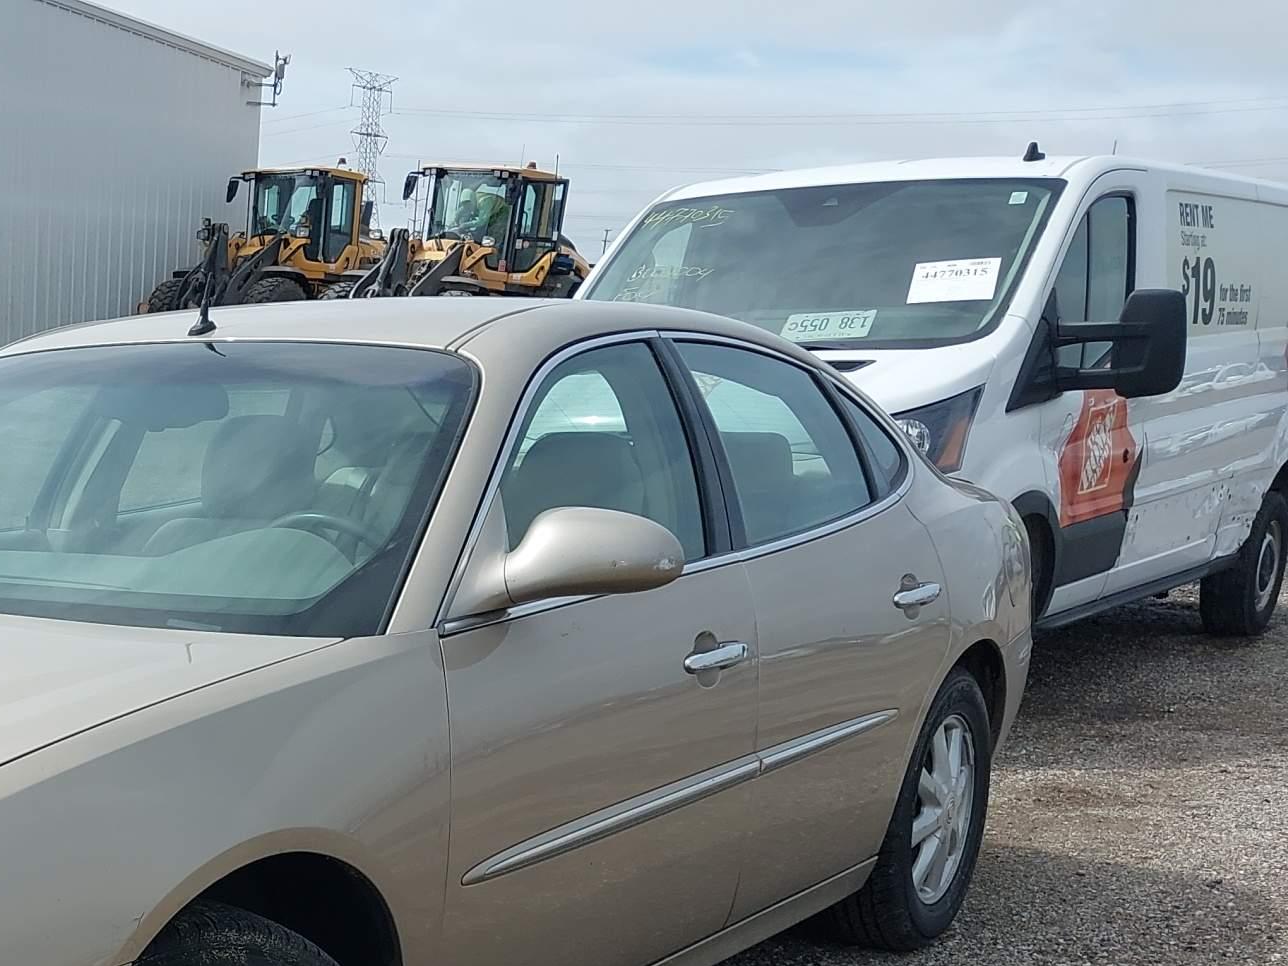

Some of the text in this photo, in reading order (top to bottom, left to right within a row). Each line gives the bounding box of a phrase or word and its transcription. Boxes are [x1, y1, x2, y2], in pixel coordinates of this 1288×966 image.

[1179, 203, 1214, 229] RENT ME
[922, 268, 990, 279] 44770315
[1182, 256, 1216, 325] $19
[1220, 283, 1251, 304] for the first
[838, 316, 869, 330] 138
[1217, 307, 1248, 326] 75 minutes
